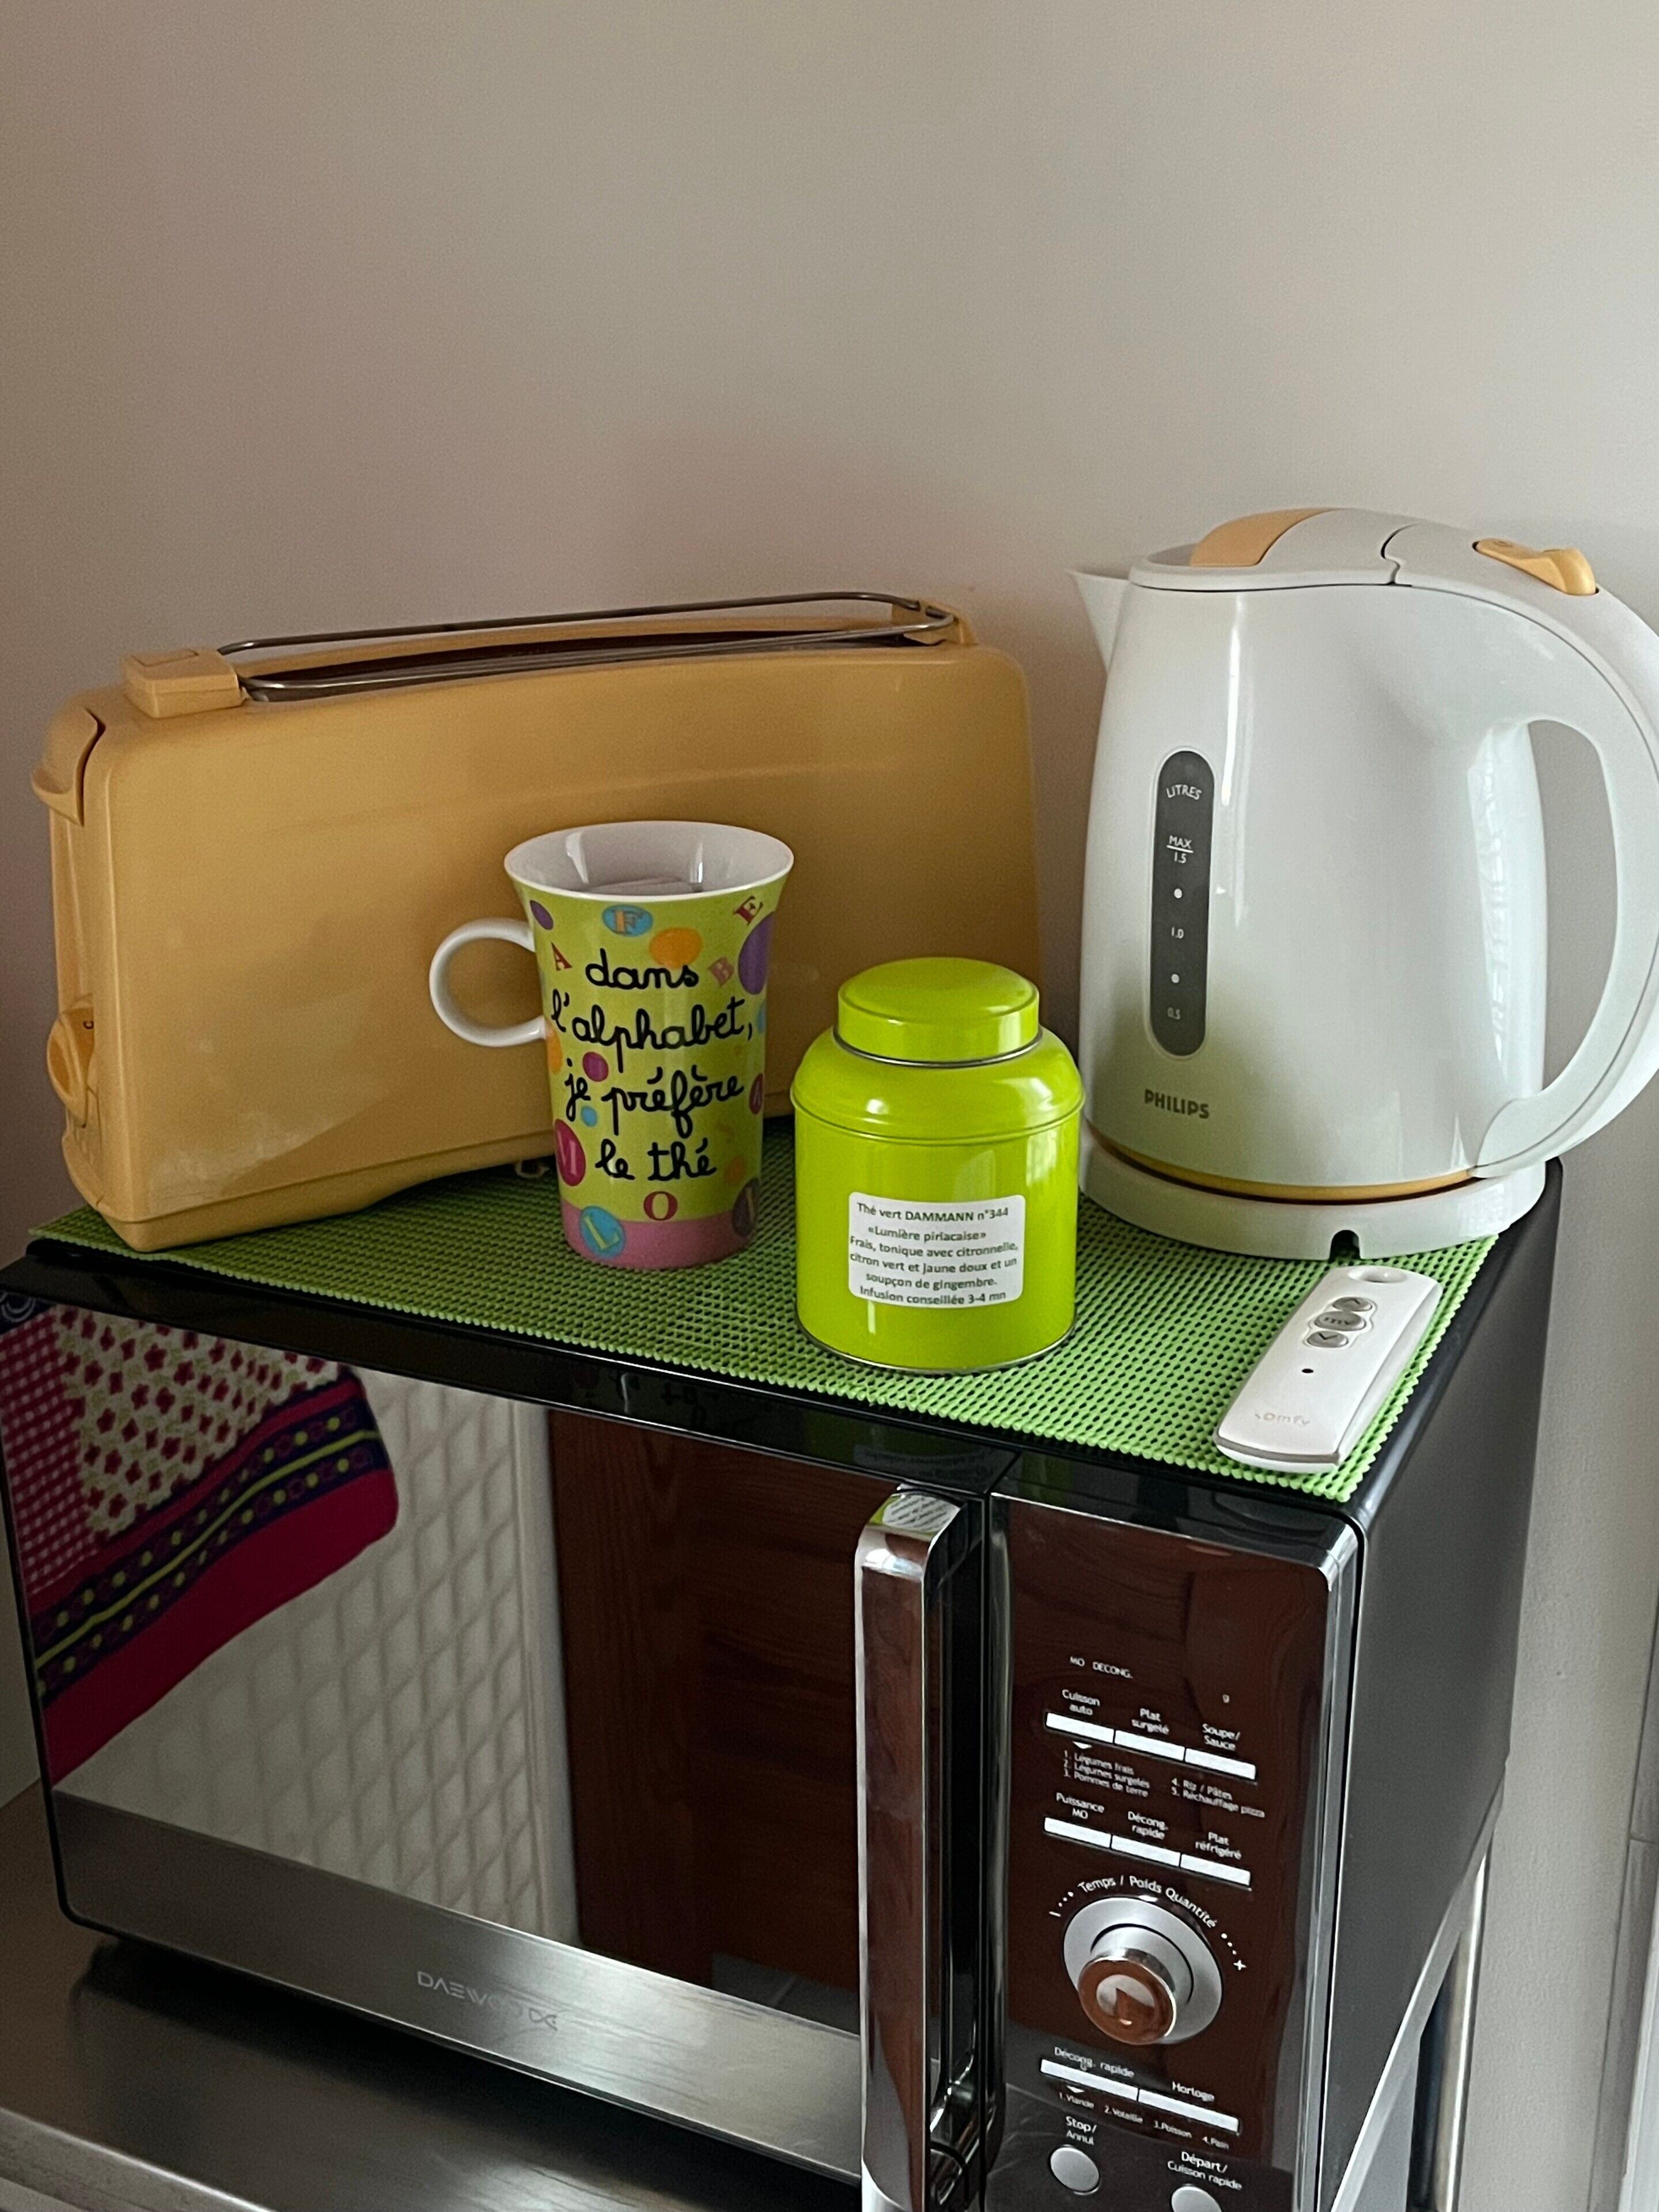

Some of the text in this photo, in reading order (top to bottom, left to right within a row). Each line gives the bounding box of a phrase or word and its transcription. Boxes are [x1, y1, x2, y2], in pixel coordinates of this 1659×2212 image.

[1166, 784, 1202, 800] LITRES
[1169, 835, 1192, 850] MAX
[1174, 851, 1187, 863] 1.5
[733, 895, 764, 926] E
[613, 909, 643, 935] F
[1171, 926, 1184, 939] 1.0
[551, 941, 572, 971] A
[585, 948, 699, 990] dans
[707, 957, 735, 987] B
[1168, 1007, 1180, 1020] 0.5
[551, 989, 752, 1073] l'alphabet,
[565, 1058, 744, 1139] je préfère
[1145, 1089, 1209, 1119] PHILIPS
[594, 1138, 717, 1181] le thé
[643, 1191, 677, 1221] O
[857, 1202, 1008, 1221] Thé vert DAMMANN n°344
[583, 1214, 620, 1251] L
[868, 1226, 920, 1240] «Lumière
[879, 1243, 923, 1257] tonique
[956, 1241, 1018, 1257] citronnelle,
[850, 1252, 1017, 1275] citron vert et jaune doux et un
[866, 1273, 997, 1291] soupçon de gingembre.
[861, 1286, 1006, 1307] Infusion conseillée 3-4 mn
[1070, 1656, 1134, 1679] MO DECONG.
[1062, 1689, 1100, 1707] Cuisson
[1070, 1704, 1093, 1715] auto
[1139, 1708, 1161, 1722] Plat
[1131, 1719, 1169, 1734] surgelé
[1204, 1735, 1236, 1751] Sauce
[1074, 1771, 1110, 1788] Pommes
[1112, 1782, 1123, 1791] de
[1056, 1792, 1105, 1813] Puissance
[1183, 1790, 1238, 1812] Réchauffage
[1072, 1808, 1088, 1819] MO
[1128, 1811, 1169, 1831] Décong.
[1132, 1825, 1165, 1840] rapide
[1209, 1832, 1229, 1846] Plat
[1195, 1840, 1242, 1860] réfrigéré
[1078, 1875, 1218, 1929] Temps / Poids Quantité
[1100, 2062, 1134, 2078] rapide
[1172, 2081, 1215, 2102] Horloge
[1066, 2116, 1097, 2134] Stop/
[1066, 2130, 1094, 2145] Annul
[1181, 2151, 1228, 2173] Départ/
[1168, 2160, 1243, 2191] Cuisson rapide
